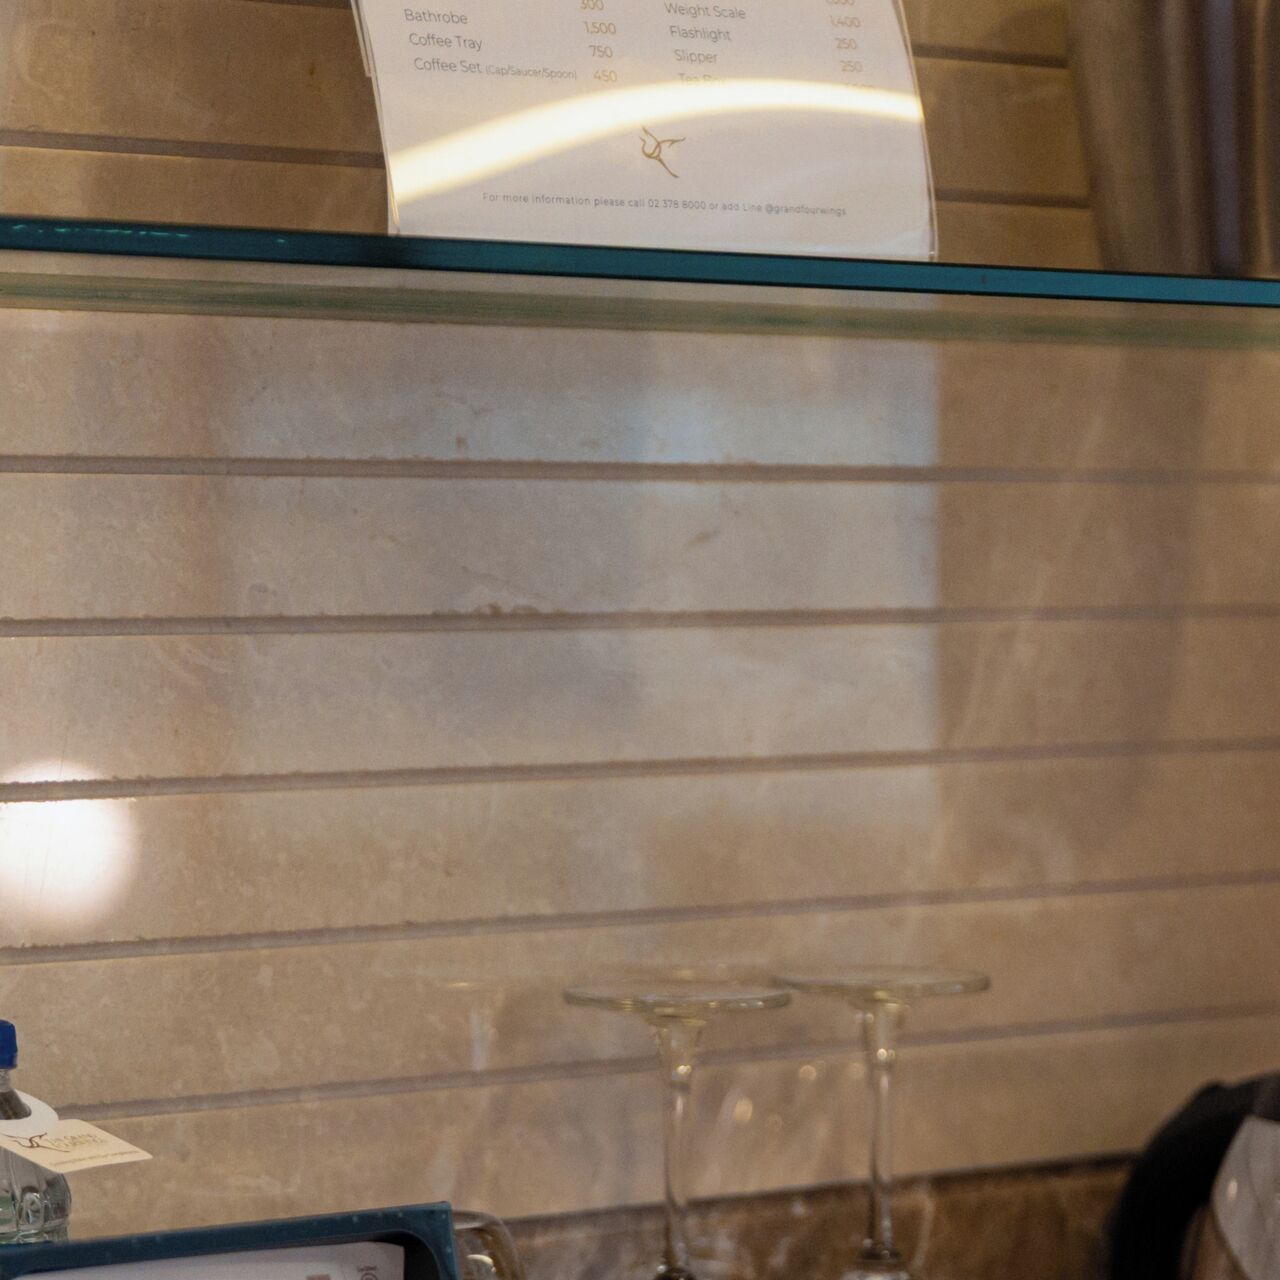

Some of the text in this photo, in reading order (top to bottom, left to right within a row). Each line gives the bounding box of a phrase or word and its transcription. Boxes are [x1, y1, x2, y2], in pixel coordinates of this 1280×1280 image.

[404, 8, 468, 25] Bathrobe
[664, 1, 747, 19] Weight Scale
[409, 32, 483, 52] Coffee Tray
[669, 25, 732, 43] Flashlight
[589, 44, 613, 58] 750
[834, 37, 857, 51] 250
[414, 56, 457, 73] Coffee
[459, 60, 482, 74] Set
[674, 49, 718, 65] Slipper
[840, 59, 864, 74] 250
[593, 69, 618, 83] 450
[482, 192, 499, 202] For
[503, 194, 528, 203] more
[532, 194, 591, 206] information
[594, 196, 625, 208] please
[628, 197, 645, 208] call
[648, 199, 660, 208] 02
[663, 199, 679, 209] 378
[682, 200, 707, 210] 8000
[709, 202, 719, 210] or
[722, 202, 740, 212] add
